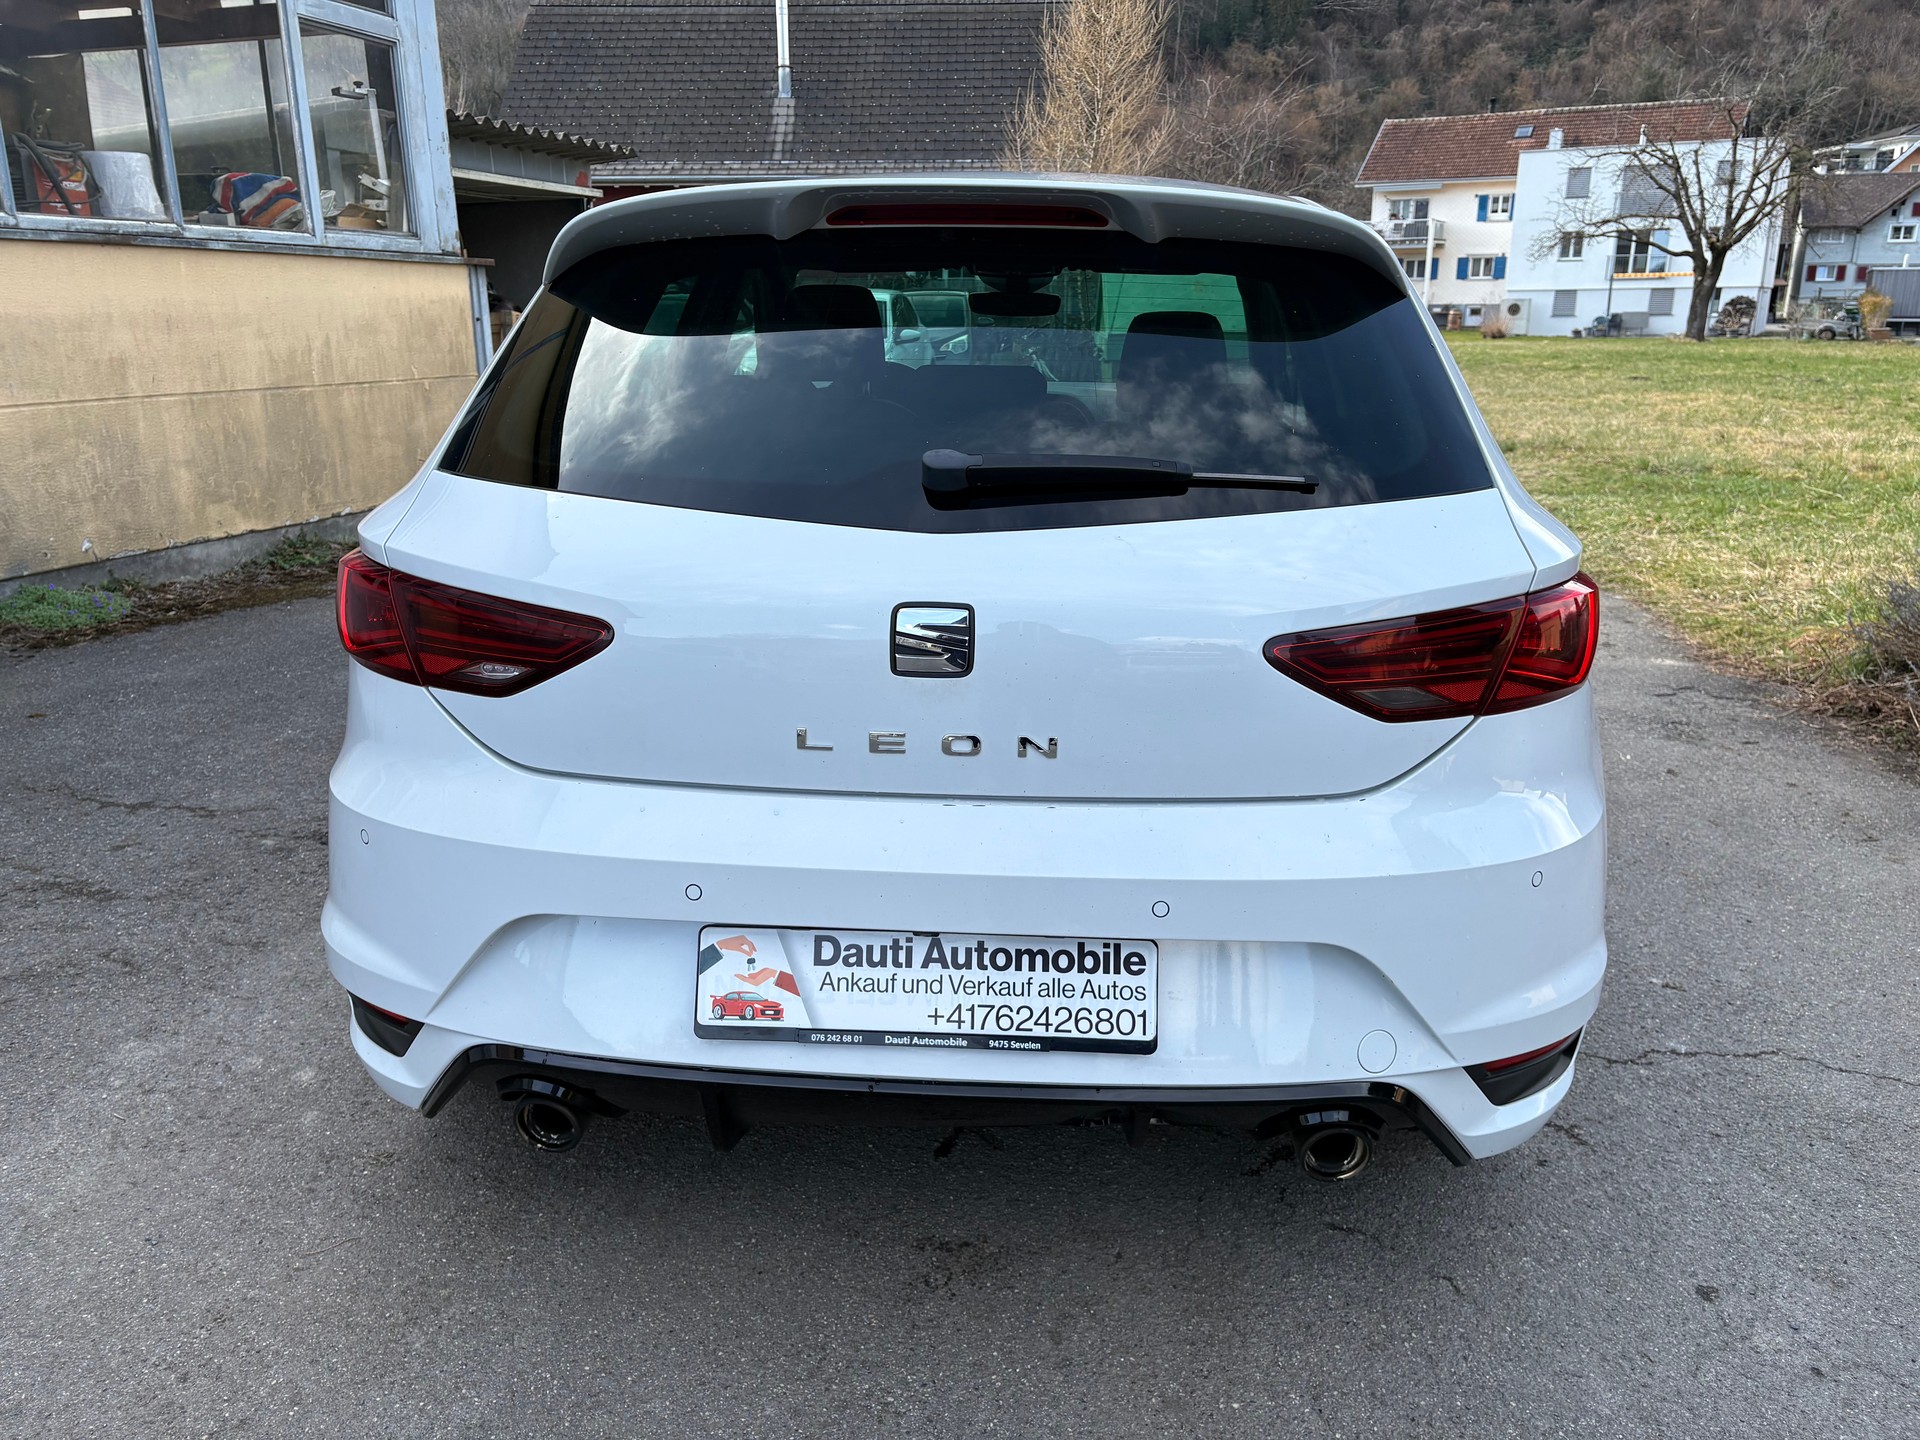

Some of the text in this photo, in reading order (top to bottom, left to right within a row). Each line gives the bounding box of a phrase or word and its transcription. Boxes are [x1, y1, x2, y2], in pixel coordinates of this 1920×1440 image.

[796, 727, 1059, 759] LEON
[813, 935, 1147, 976] Dauti Automobile
[819, 972, 1147, 1001] Ankauf und Verkauf alle Autos
[927, 1003, 1148, 1036] +41762426801
[810, 1033, 863, 1043] 076 242 68 01
[884, 1035, 968, 1047] Dauti Automobile
[988, 1040, 1041, 1050] 9475 Sevelen
